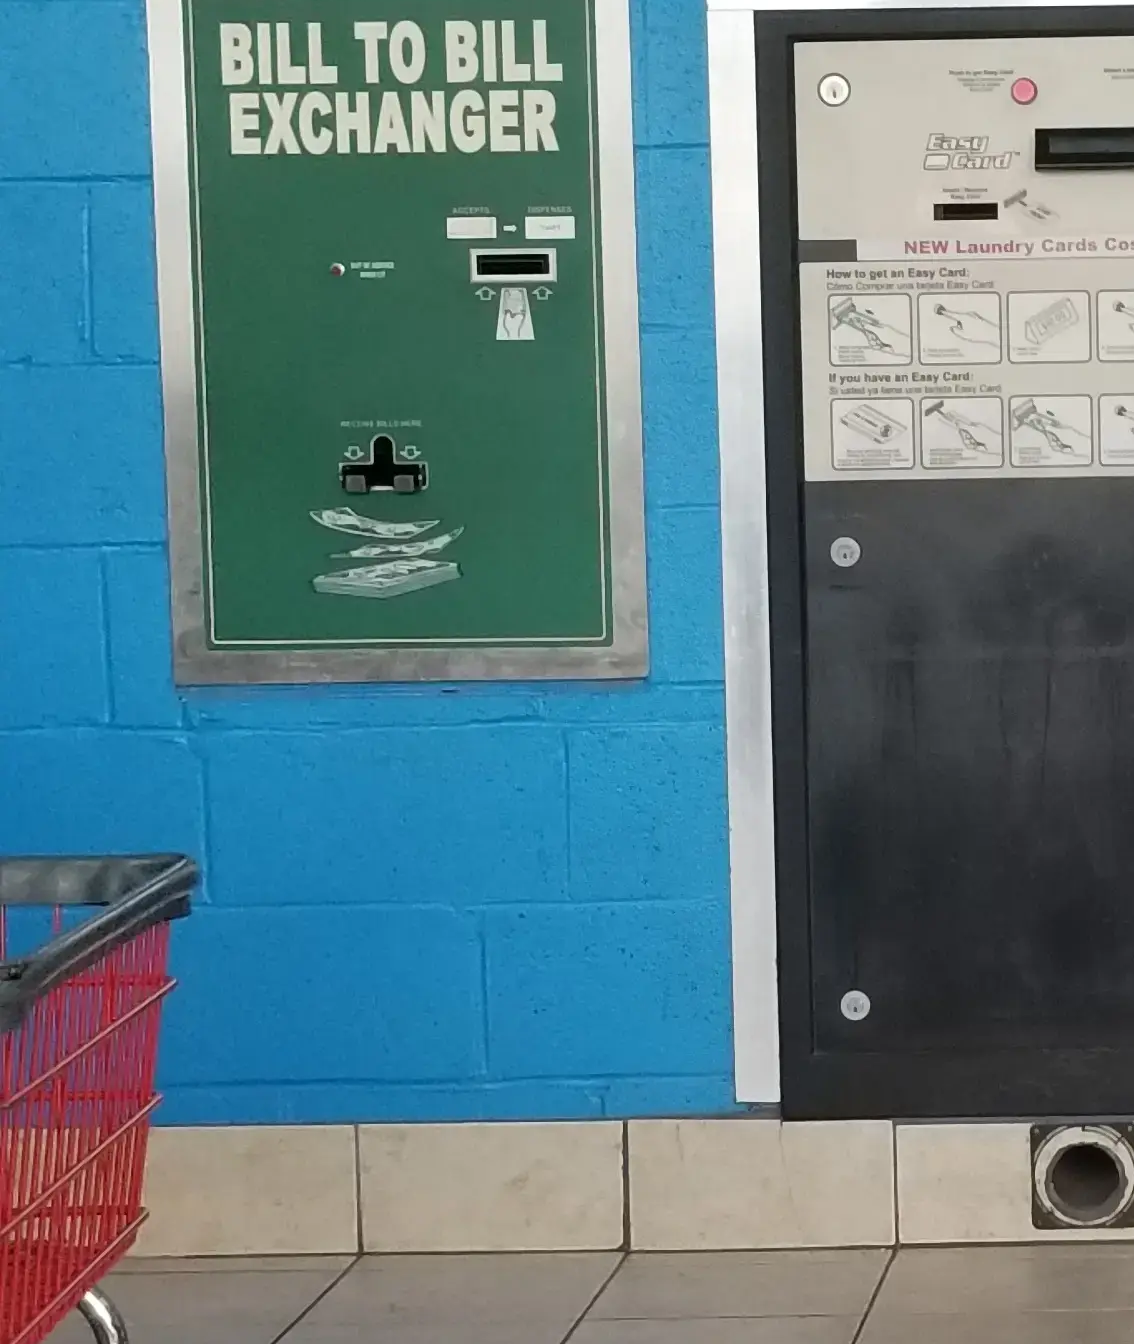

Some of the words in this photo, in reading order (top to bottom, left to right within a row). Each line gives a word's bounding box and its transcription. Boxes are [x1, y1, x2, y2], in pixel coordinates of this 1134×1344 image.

[219, 22, 339, 86] BILL
[353, 20, 427, 84] TO
[444, 19, 564, 83] BILL
[228, 89, 560, 155] EXCHANGER
[926, 133, 989, 154] Easy
[951, 151, 1012, 170] Card
[904, 241, 948, 254] NEW
[956, 240, 1034, 256] Laundry
[1041, 239, 1098, 252] Cards
[826, 269, 851, 279] How
[854, 269, 866, 278] to
[869, 269, 888, 280] get
[890, 269, 904, 278] an
[908, 268, 935, 279] Easy
[938, 267, 970, 277] Card:
[946, 280, 969, 290] Easy
[971, 280, 994, 289] Card
[829, 373, 836, 382] If
[839, 374, 861, 385] you
[864, 373, 891, 383] have
[895, 373, 909, 382] an
[912, 372, 940, 383] Easy
[943, 371, 974, 382] Card:
[954, 385, 977, 394] Easy
[979, 384, 1002, 393] Card
